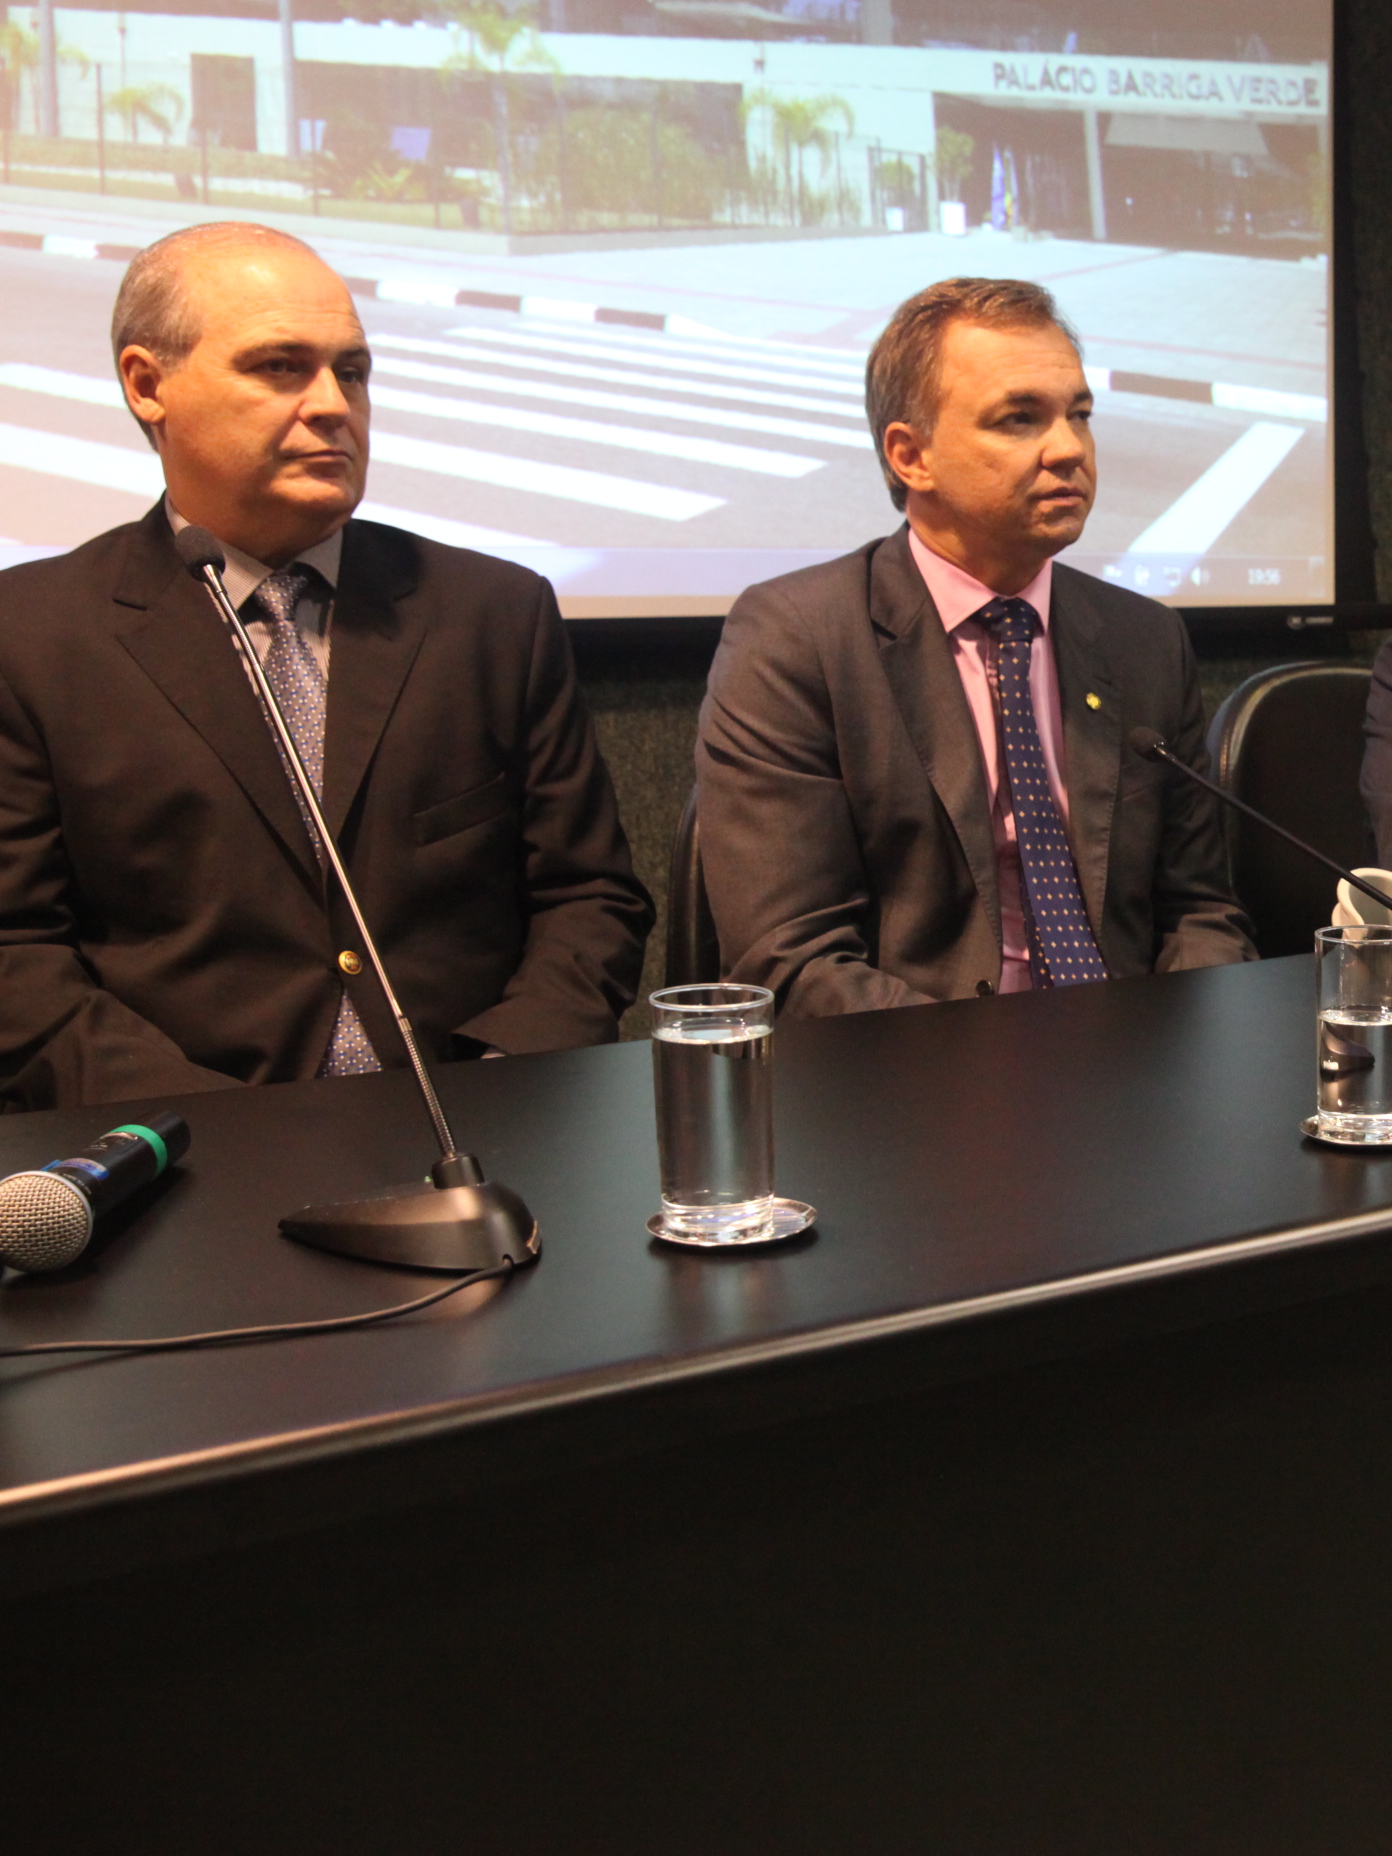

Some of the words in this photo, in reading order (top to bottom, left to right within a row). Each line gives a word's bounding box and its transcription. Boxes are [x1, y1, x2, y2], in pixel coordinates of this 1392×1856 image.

[993, 59, 1096, 94] PALÁCIO
[1107, 68, 1223, 102] BARRIGA
[1226, 75, 1320, 107] VERDE
